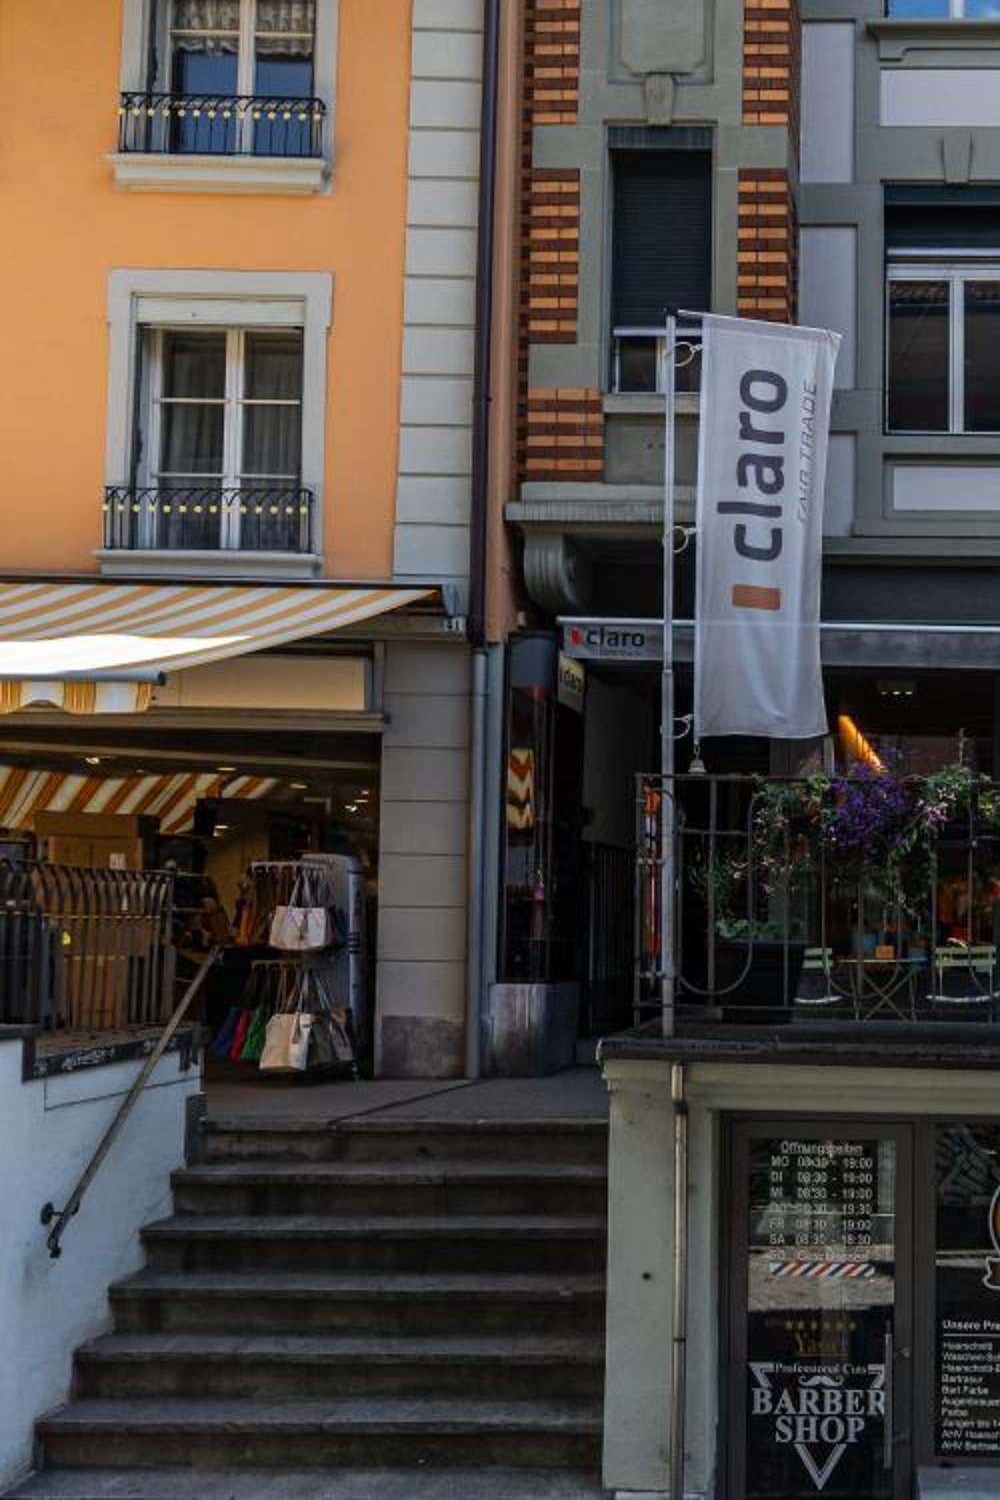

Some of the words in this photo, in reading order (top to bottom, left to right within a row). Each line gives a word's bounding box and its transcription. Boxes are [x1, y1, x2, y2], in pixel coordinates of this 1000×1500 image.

[799, 380, 817, 464] TRADE
[717, 369, 788, 562] claro
[586, 627, 645, 647] claro
[771, 1171, 783, 1182] DI
[769, 1233, 786, 1245] SA
[942, 1319, 980, 1331] Unsere
[752, 1387, 886, 1415] BARBER
[775, 1415, 865, 1443] SHOP
